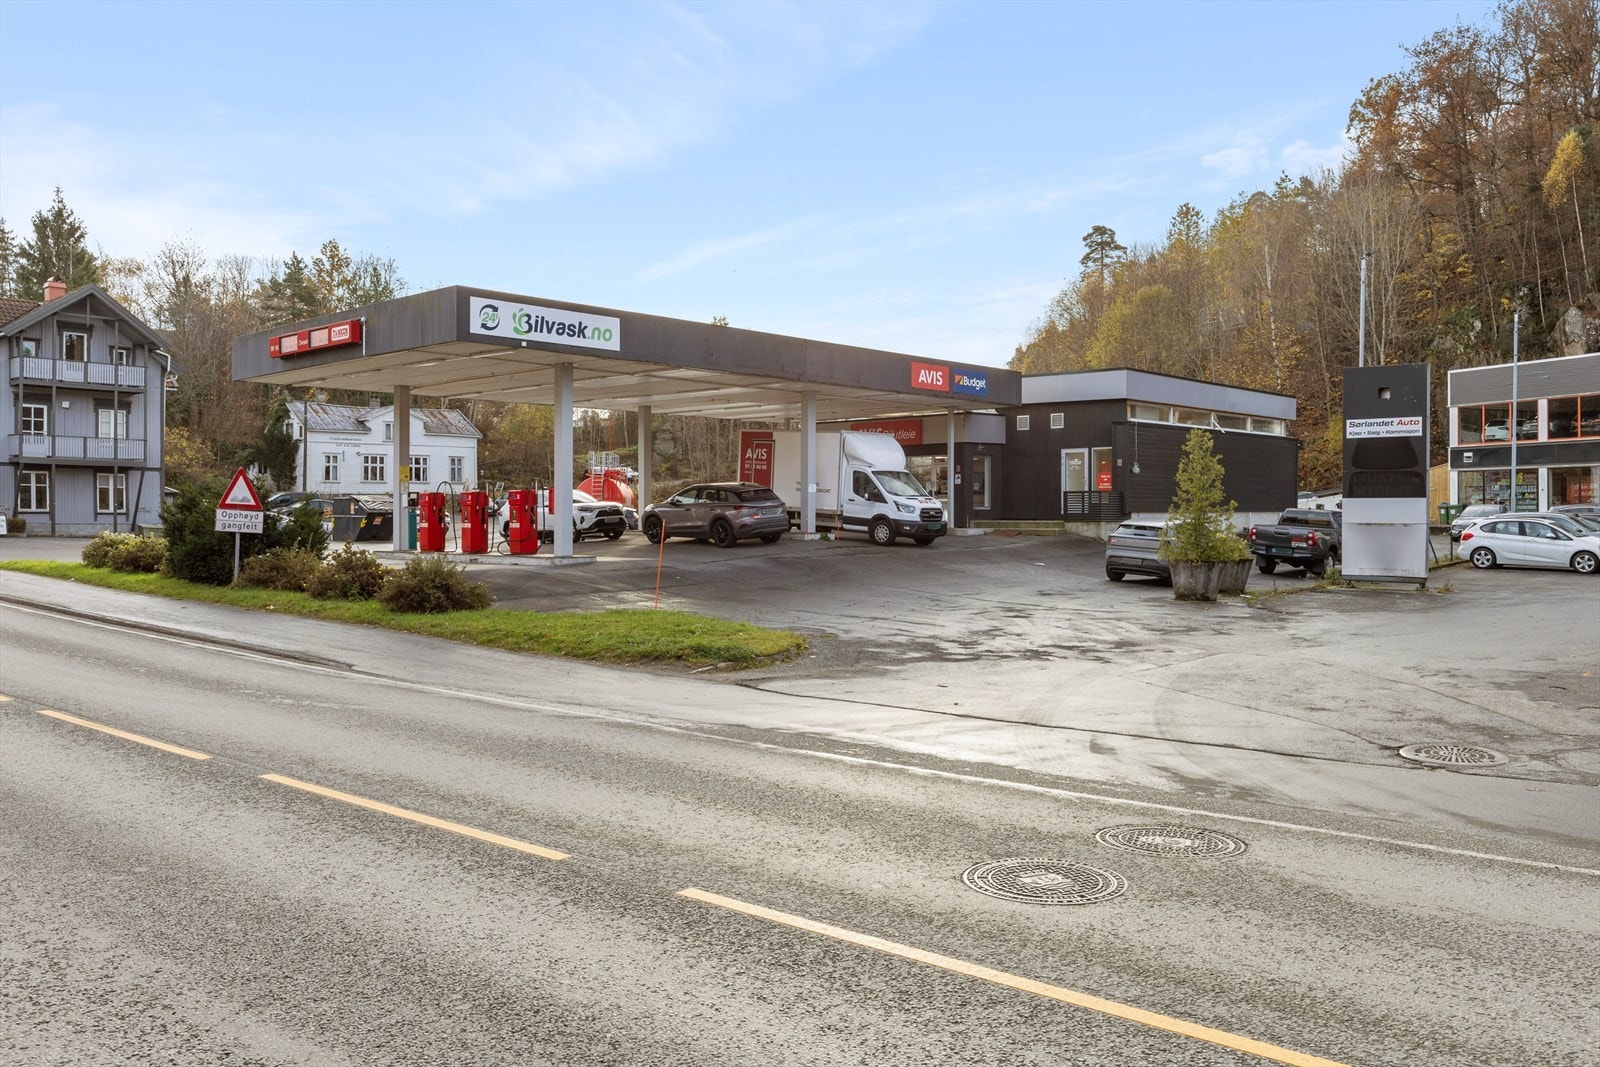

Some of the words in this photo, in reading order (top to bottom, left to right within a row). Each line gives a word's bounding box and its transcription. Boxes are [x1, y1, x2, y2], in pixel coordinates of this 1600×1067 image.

[512, 308, 613, 342] Bilvask.no
[918, 369, 943, 386] AVIS
[963, 375, 986, 390] Budget
[1349, 420, 1394, 428] Sørlandet
[745, 448, 767, 460] AVIS
[221, 511, 259, 521] Opphøyd
[221, 522, 258, 530] gangfelt
